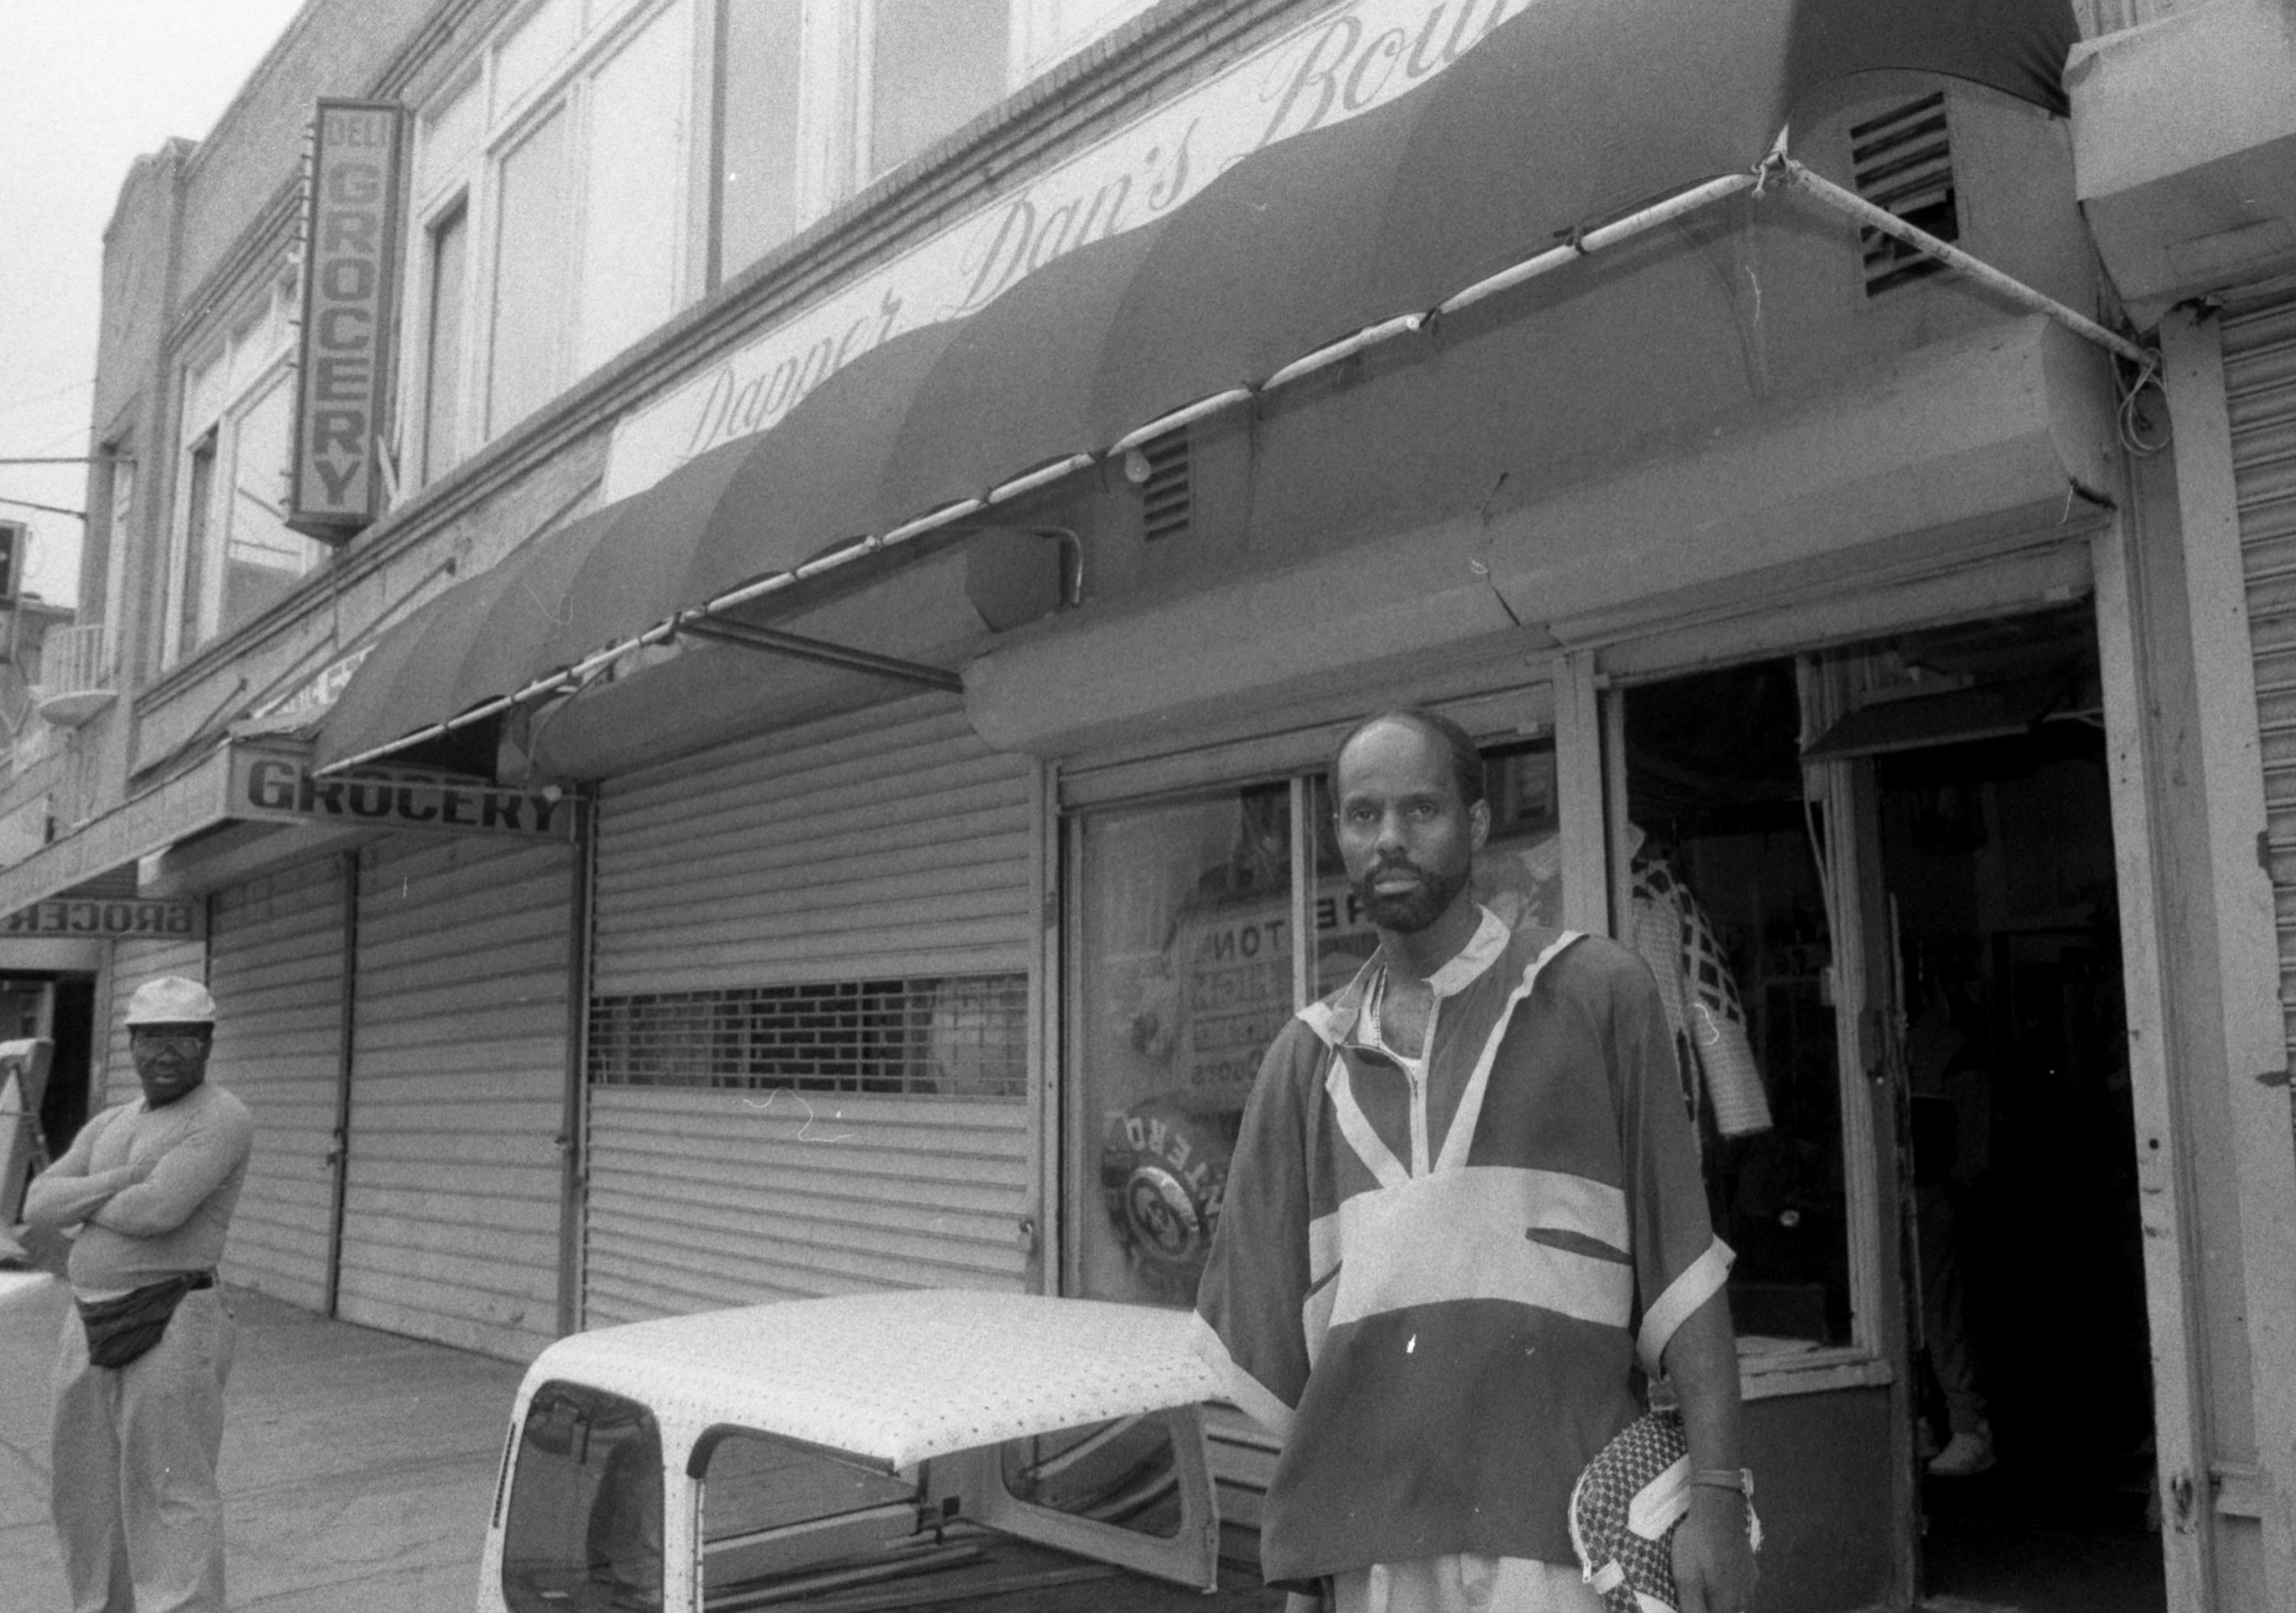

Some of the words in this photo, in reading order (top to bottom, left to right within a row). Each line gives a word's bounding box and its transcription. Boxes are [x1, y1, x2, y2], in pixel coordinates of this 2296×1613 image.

[325, 116, 390, 148] DELI
[311, 160, 382, 507] GROCERY
[686, 285, 903, 456] Dapper
[935, 112, 1203, 318] Dan's
[248, 759, 562, 833] GROCERY
